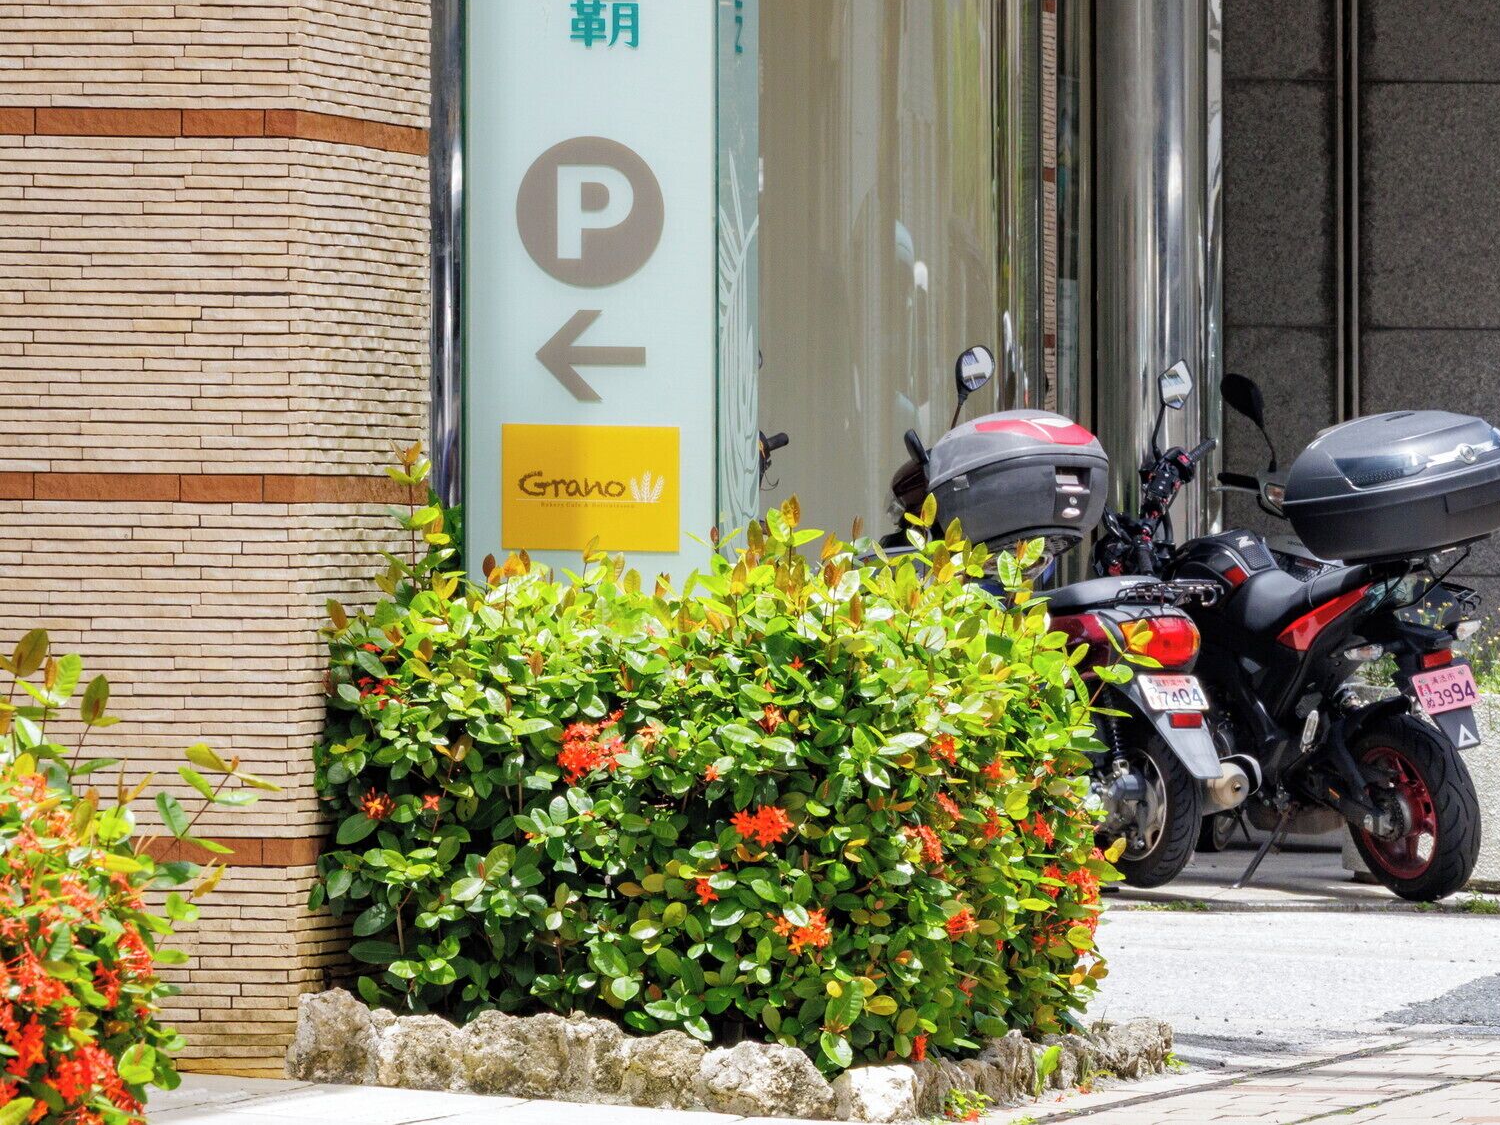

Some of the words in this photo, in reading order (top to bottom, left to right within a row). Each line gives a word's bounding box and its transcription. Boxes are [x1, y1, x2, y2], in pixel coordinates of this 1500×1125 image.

[557, 164, 633, 259] P
[518, 470, 626, 498] Grano
[1158, 687, 1204, 706] 7404
[1434, 680, 1476, 707] 3994
